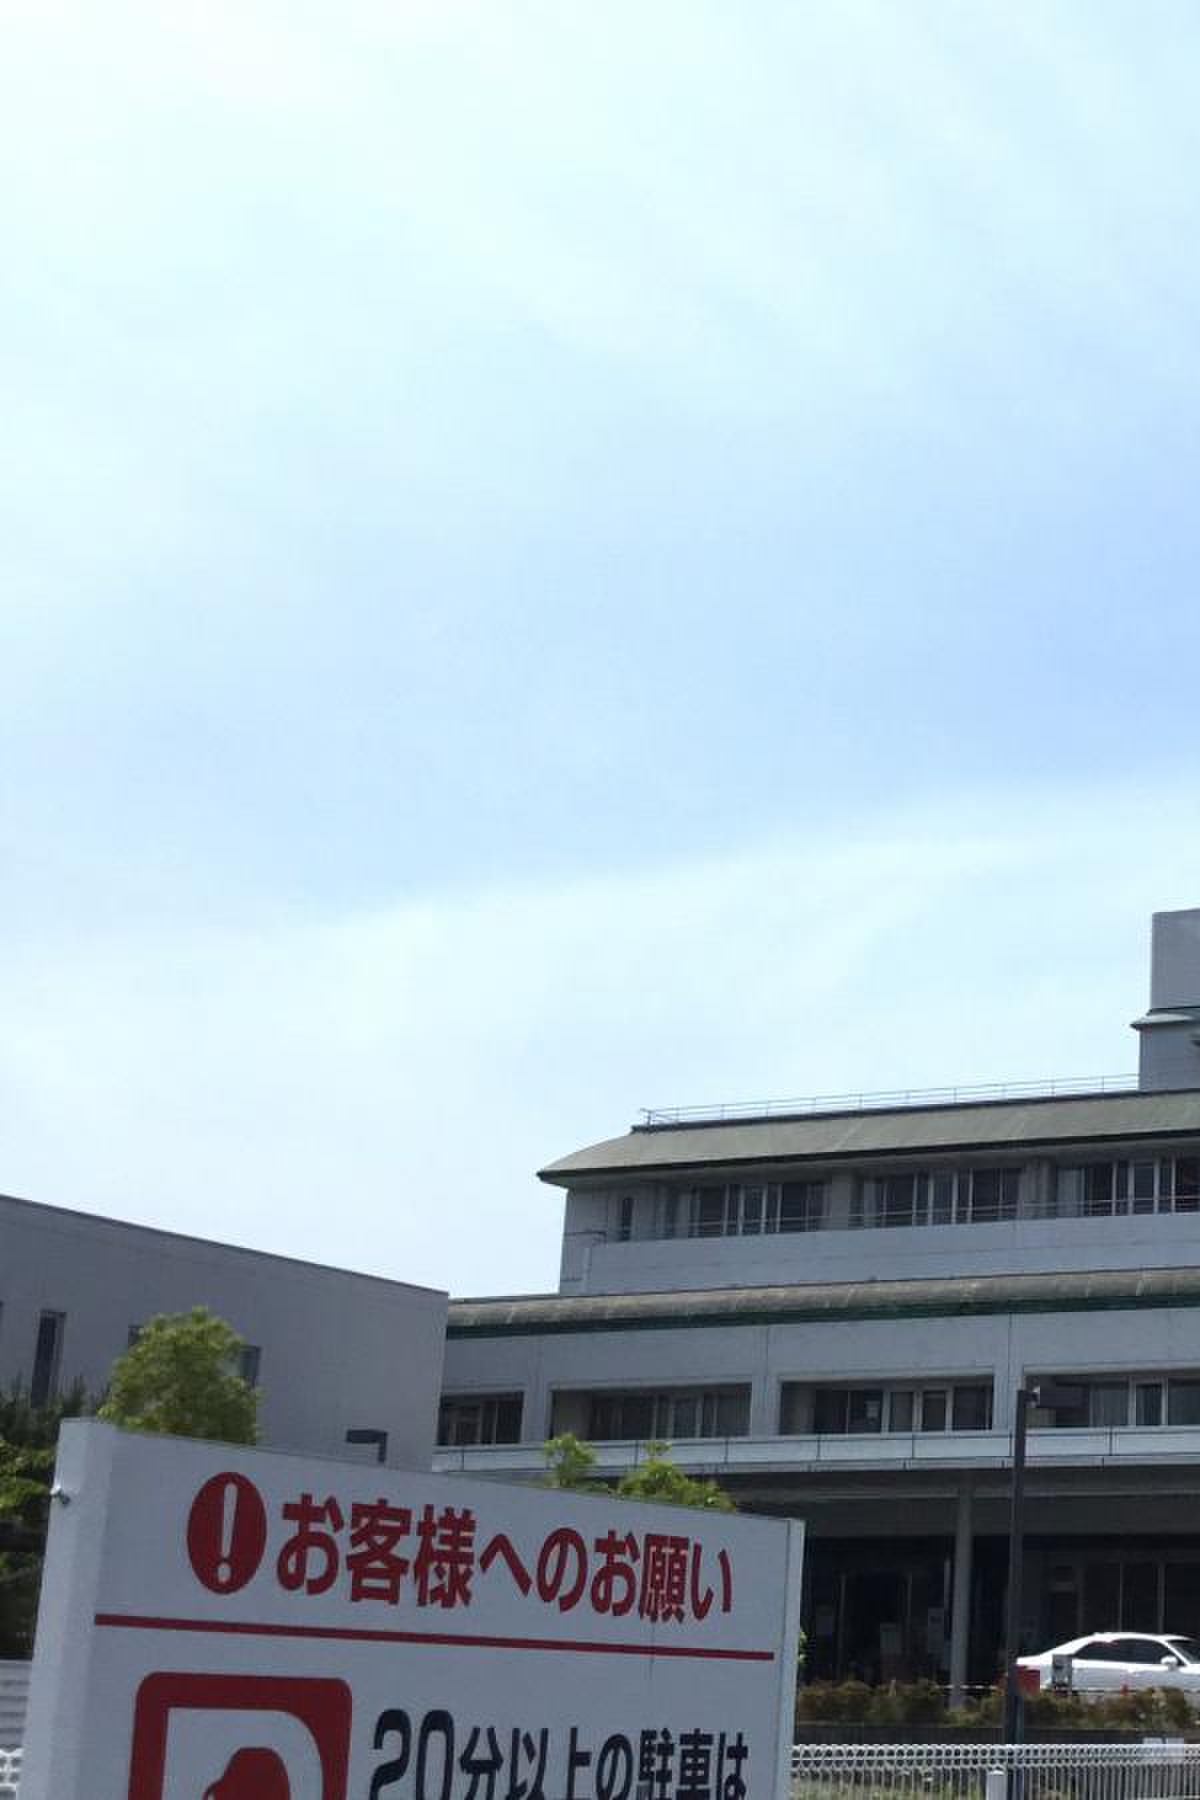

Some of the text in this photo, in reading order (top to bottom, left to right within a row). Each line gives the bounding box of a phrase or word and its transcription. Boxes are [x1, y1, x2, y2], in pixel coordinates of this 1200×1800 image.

[275, 1493, 732, 1623] お客様へのお願い
[369, 1708, 750, 1800] 20分以上の駐車は
